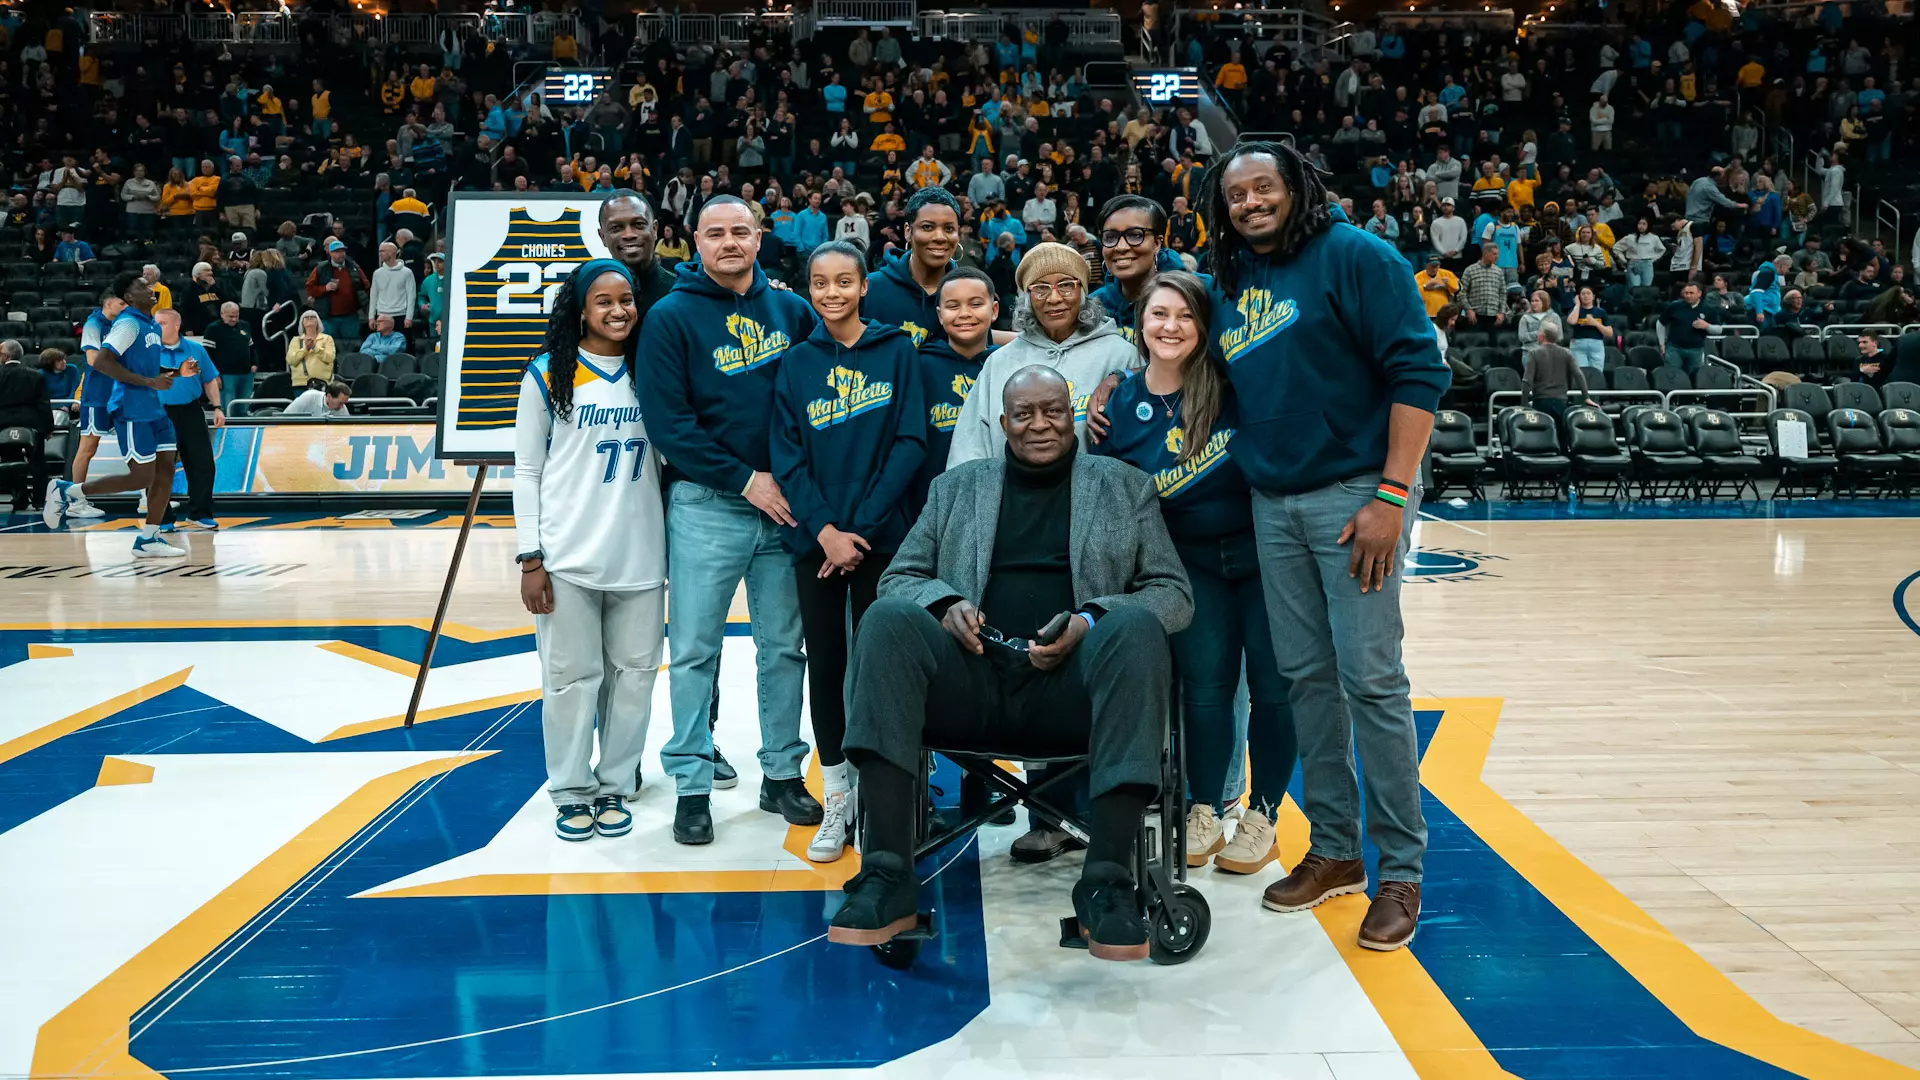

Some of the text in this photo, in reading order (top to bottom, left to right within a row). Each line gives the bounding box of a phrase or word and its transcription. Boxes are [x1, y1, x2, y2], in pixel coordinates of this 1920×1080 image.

[564, 74, 593, 101] 22
[1151, 74, 1180, 101] 22
[844, 222, 855, 233] M
[521, 244, 566, 258] CHONES
[1503, 240, 1511, 249] 4
[712, 331, 791, 370] Marquette
[806, 381, 893, 424] Marquette
[333, 436, 446, 480] JIM
[596, 437, 648, 483] 77
